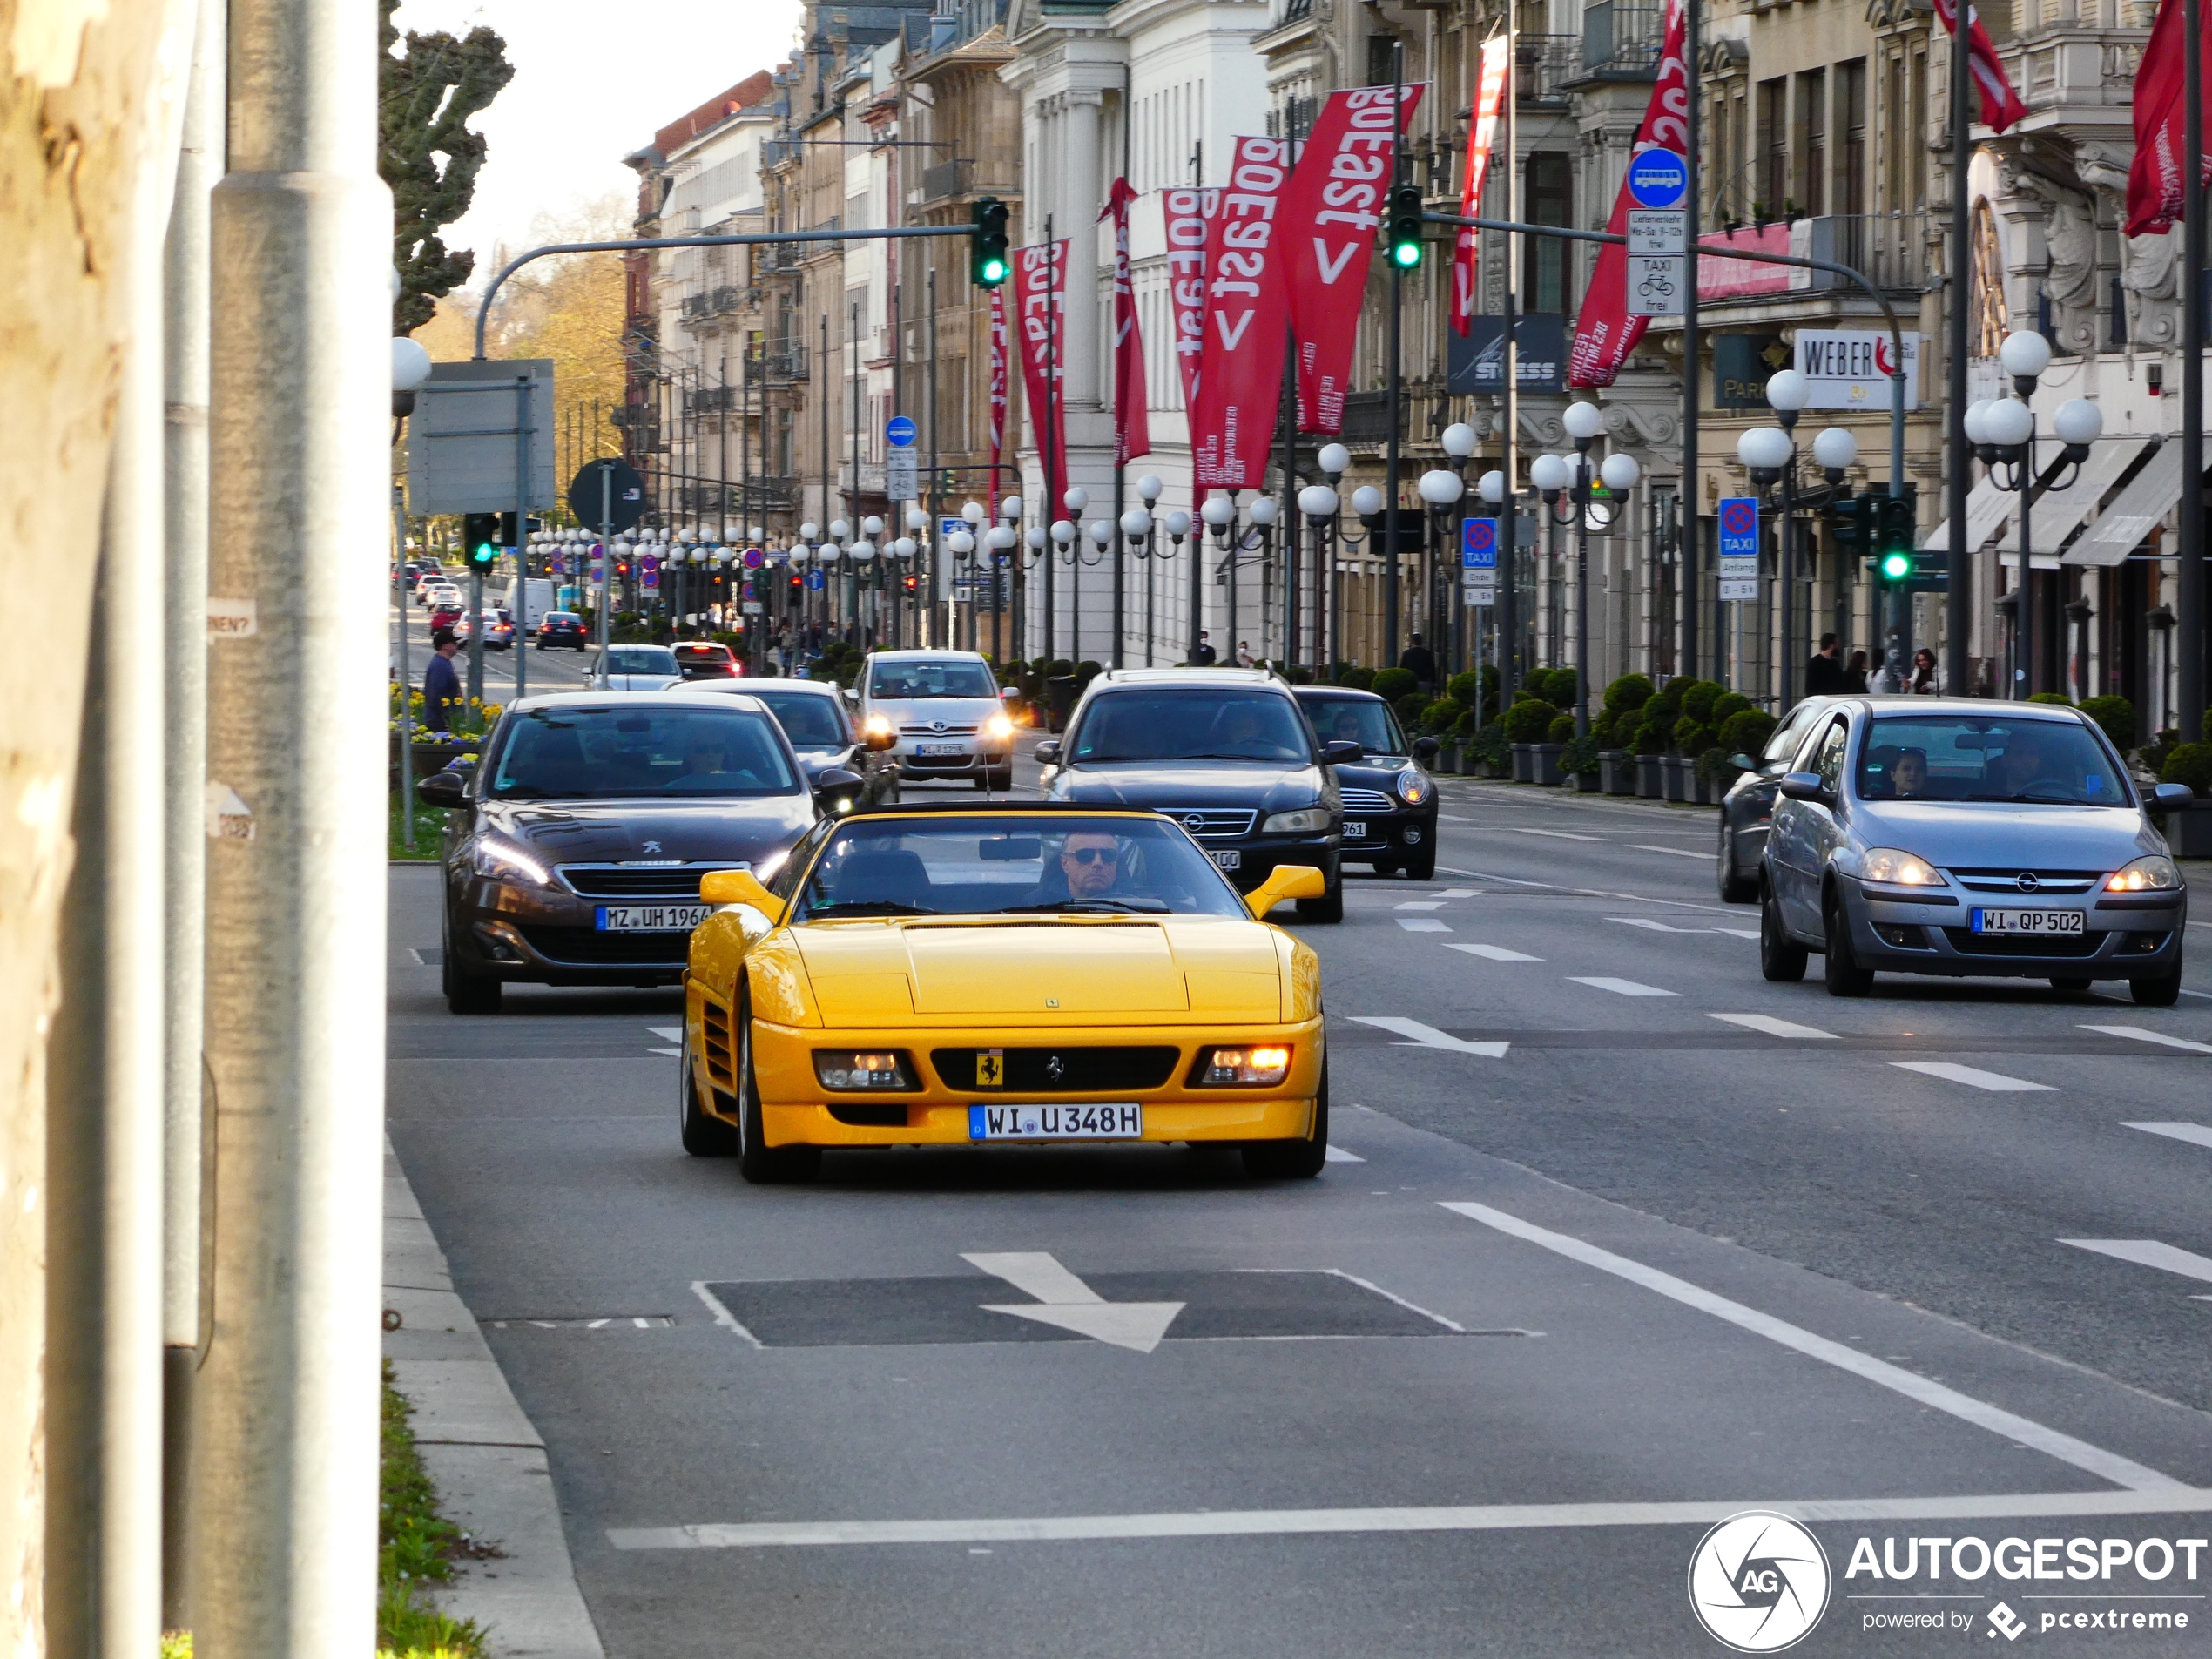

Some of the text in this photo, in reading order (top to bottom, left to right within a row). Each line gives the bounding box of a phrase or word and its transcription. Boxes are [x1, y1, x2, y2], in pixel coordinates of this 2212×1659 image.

[1315, 86, 1413, 231] goEast
[1649, 239, 1665, 248] frei
[1642, 260, 1671, 272] TAXI
[1646, 300, 1668, 311] frei
[1804, 341, 1871, 375] WEBER
[1723, 538, 1754, 550] TAXI
[1466, 552, 1494, 563] TAXI
[1723, 563, 1755, 573] Anfang
[1342, 824, 1364, 834] 961
[608, 909, 629, 927] MZ
[643, 909, 663, 927] UH
[1984, 912, 2006, 929] WI
[2020, 913, 2043, 930] QP
[2047, 914, 2081, 931] 502
[988, 1109, 1022, 1134] WI
